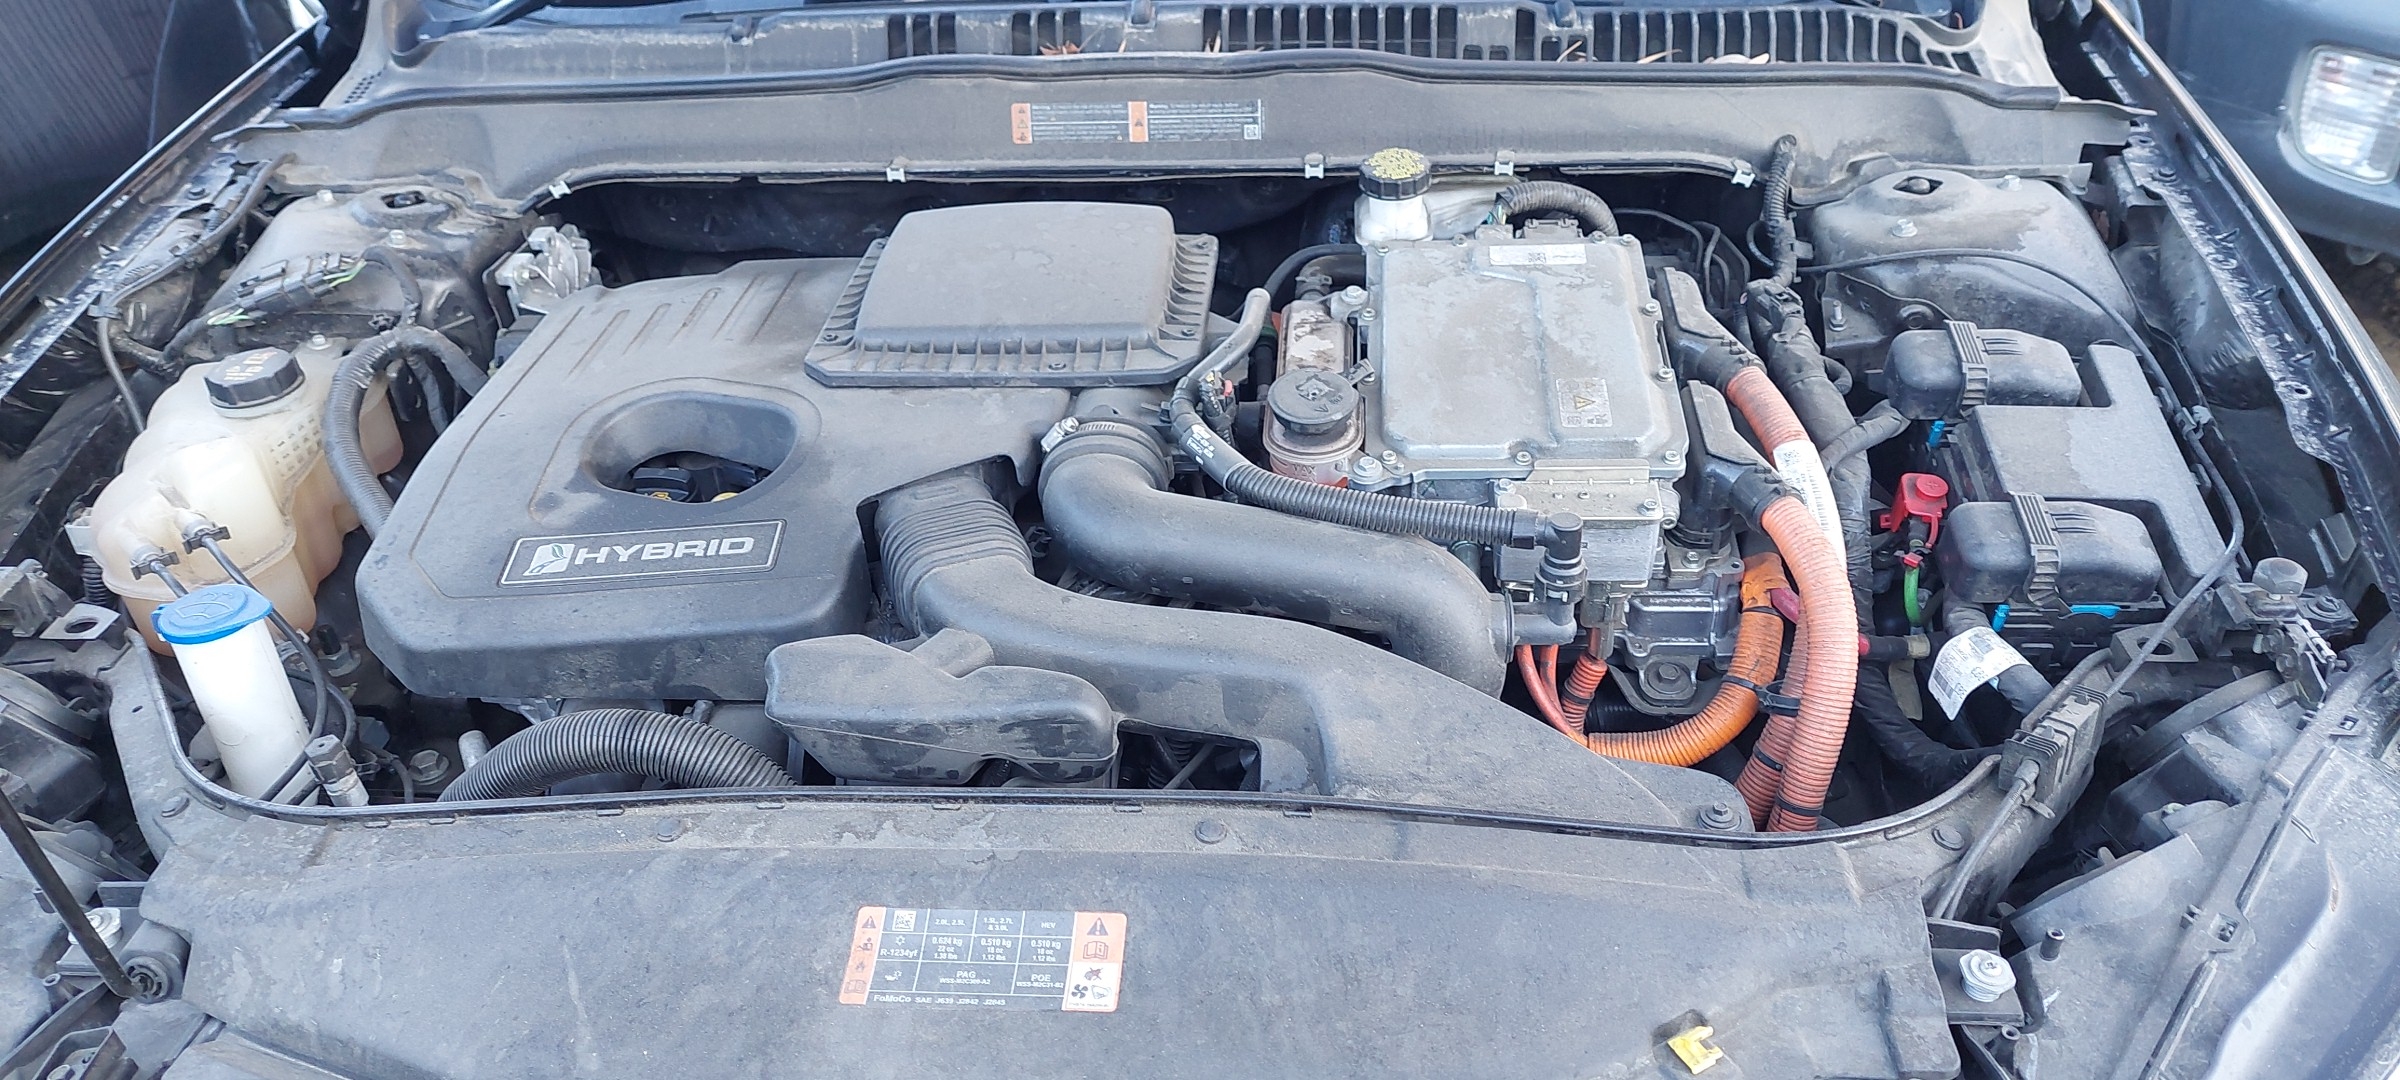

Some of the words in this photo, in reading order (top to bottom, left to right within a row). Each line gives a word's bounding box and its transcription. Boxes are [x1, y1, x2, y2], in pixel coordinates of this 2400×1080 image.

[574, 537, 755, 565] HYBRID
[932, 936, 952, 945] 0.624
[952, 937, 963, 947] kg
[980, 938, 1001, 946] 0.510
[1001, 938, 1012, 948] kg
[1030, 939, 1051, 948] 0.510
[1051, 940, 1062, 950] kg
[880, 948, 918, 958] R-1234yf
[956, 970, 976, 979] PAG
[1030, 974, 1051, 982] POE
[873, 994, 911, 1003] FoMoCo
